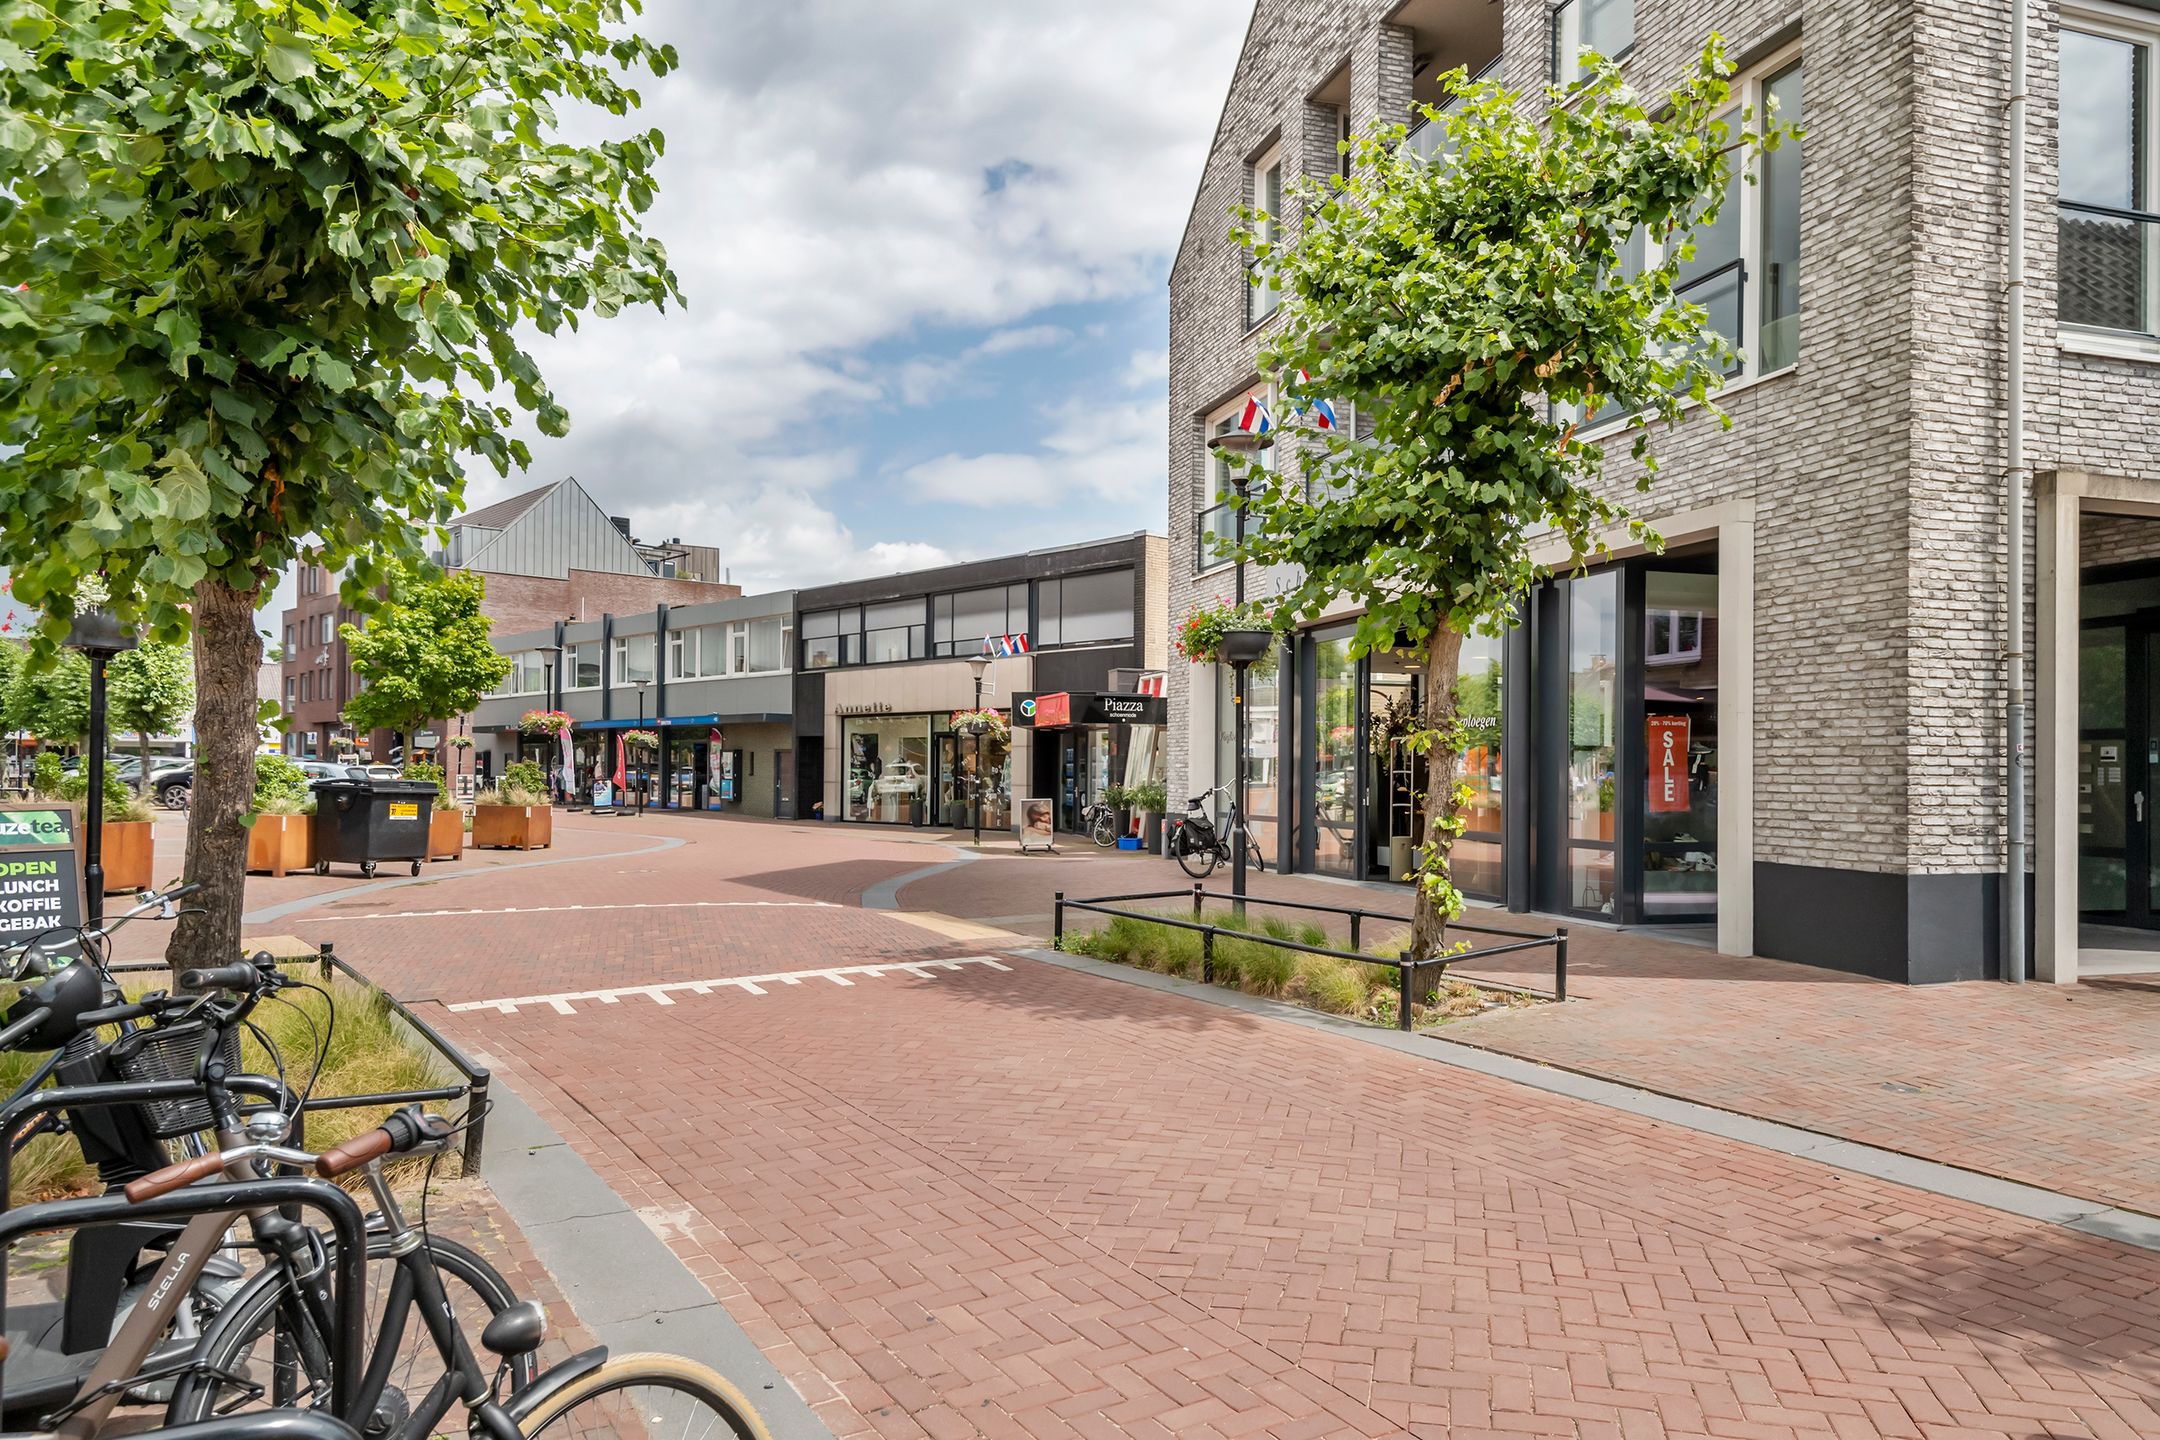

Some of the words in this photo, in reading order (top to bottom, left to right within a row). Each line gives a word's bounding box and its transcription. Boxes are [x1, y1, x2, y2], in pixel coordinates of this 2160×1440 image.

[834, 702, 893, 715] Annette
[1103, 697, 1144, 712] Piazza
[1662, 730, 1675, 802] SALE
[0, 915, 62, 932] GEBAK
[147, 1252, 191, 1312] STELLA
